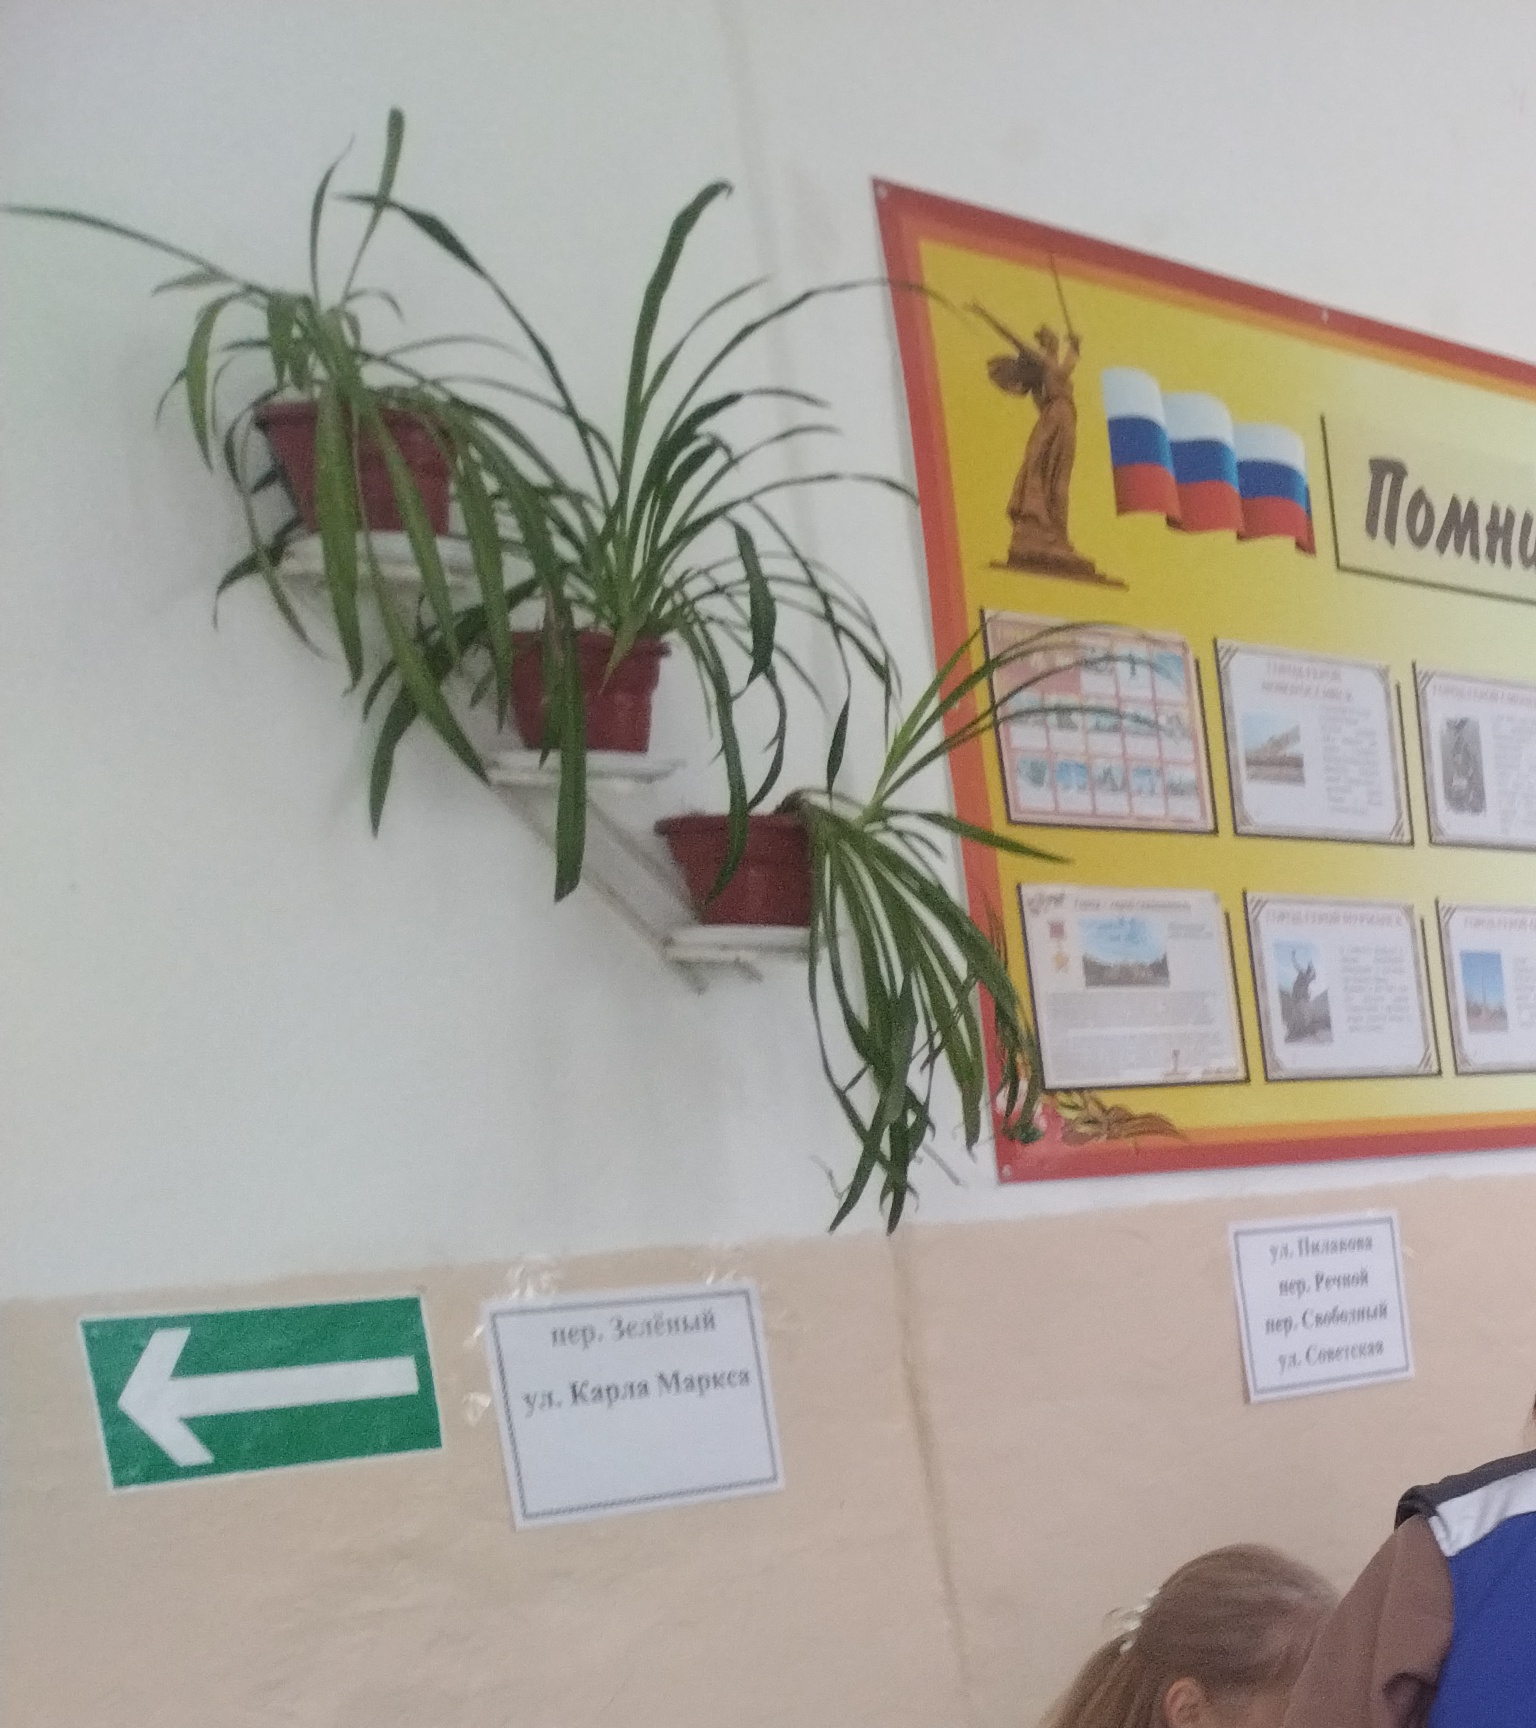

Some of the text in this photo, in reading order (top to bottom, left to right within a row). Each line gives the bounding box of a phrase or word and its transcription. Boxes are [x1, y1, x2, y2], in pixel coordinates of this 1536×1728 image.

[1269, 1243, 1295, 1264] ул.
[1279, 1265, 1369, 1299] пер. Речной
[551, 1306, 716, 1350] пер. Зелёный
[1265, 1300, 1389, 1338] пер. Свободный
[1277, 1339, 1385, 1376] ул. Советская
[522, 1367, 752, 1419] ул. Карла Маркса
